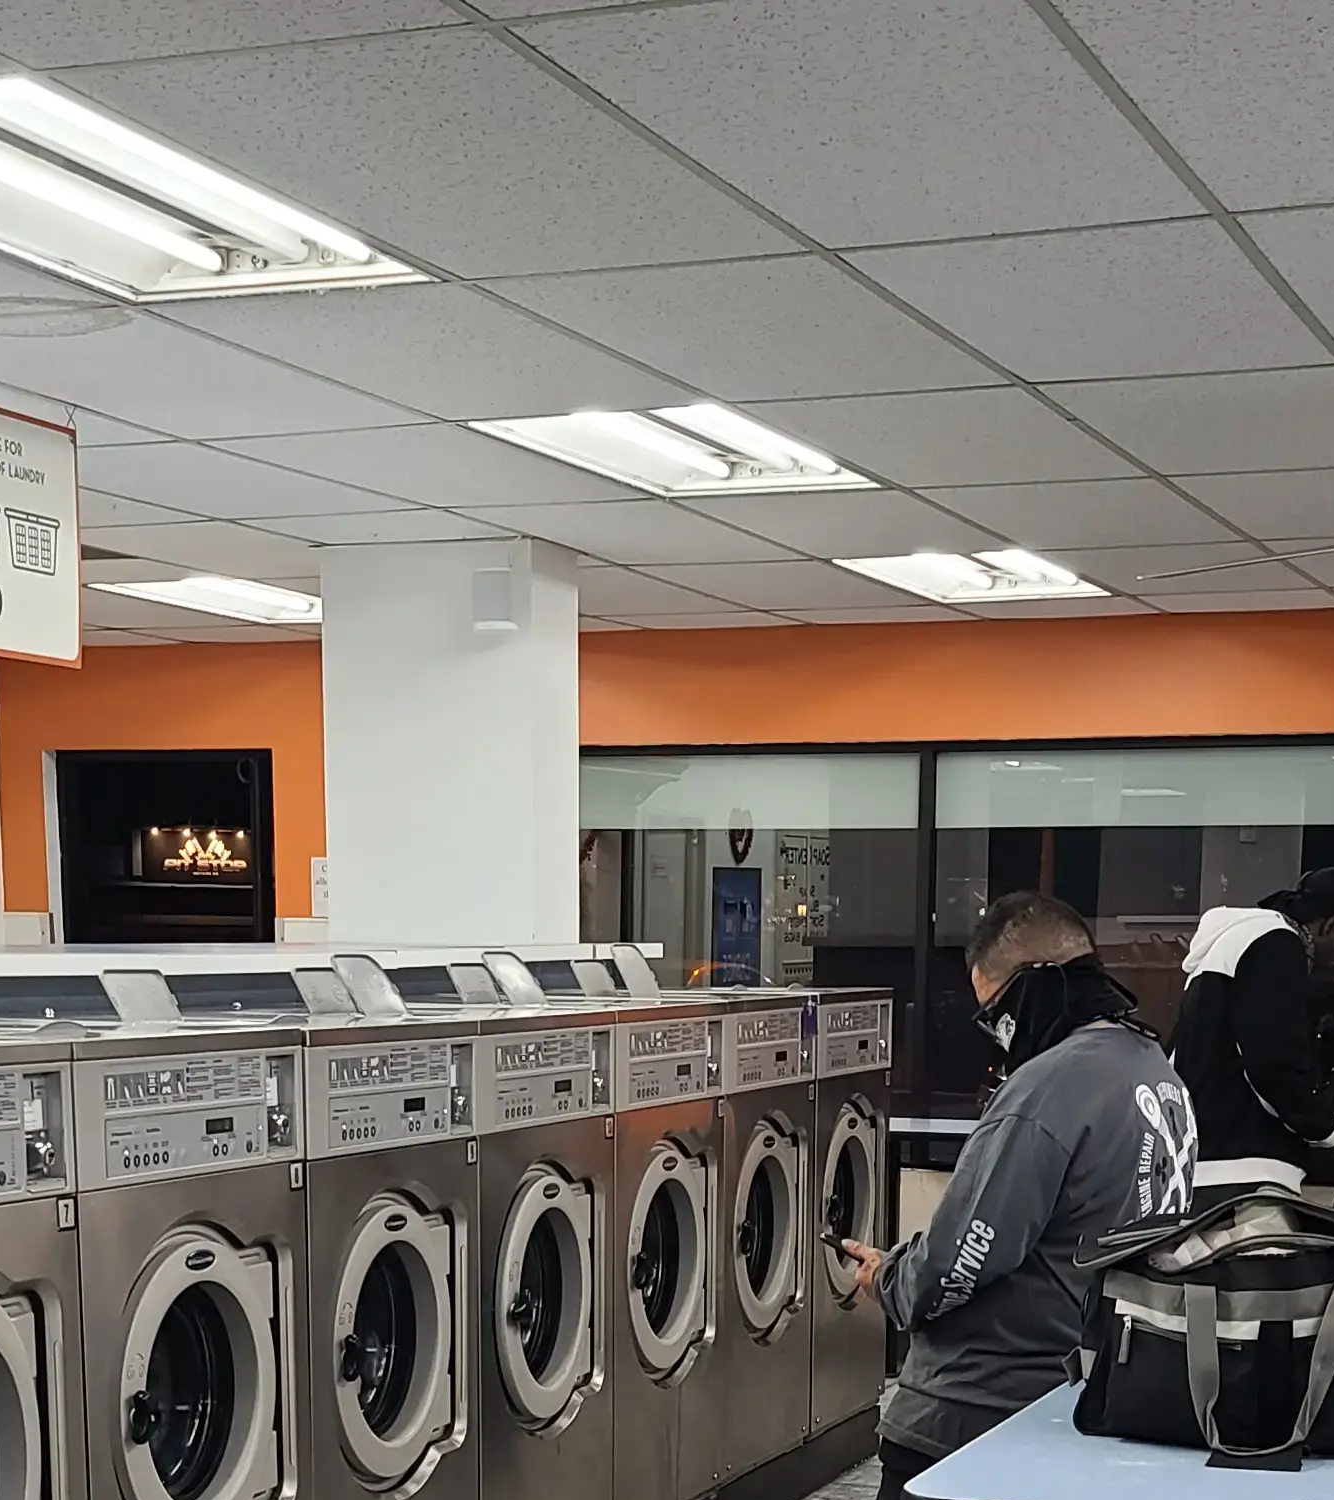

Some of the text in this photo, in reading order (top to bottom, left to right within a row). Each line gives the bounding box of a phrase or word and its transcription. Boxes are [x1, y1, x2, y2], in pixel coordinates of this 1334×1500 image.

[5, 439, 23, 457] FOR
[8, 463, 45, 487] LAUNDRY
[163, 858, 247, 872] PIT STOP
[1138, 1131, 1156, 1174] REPAIR
[63, 1203, 69, 1223] 7
[940, 1219, 995, 1294] Service
